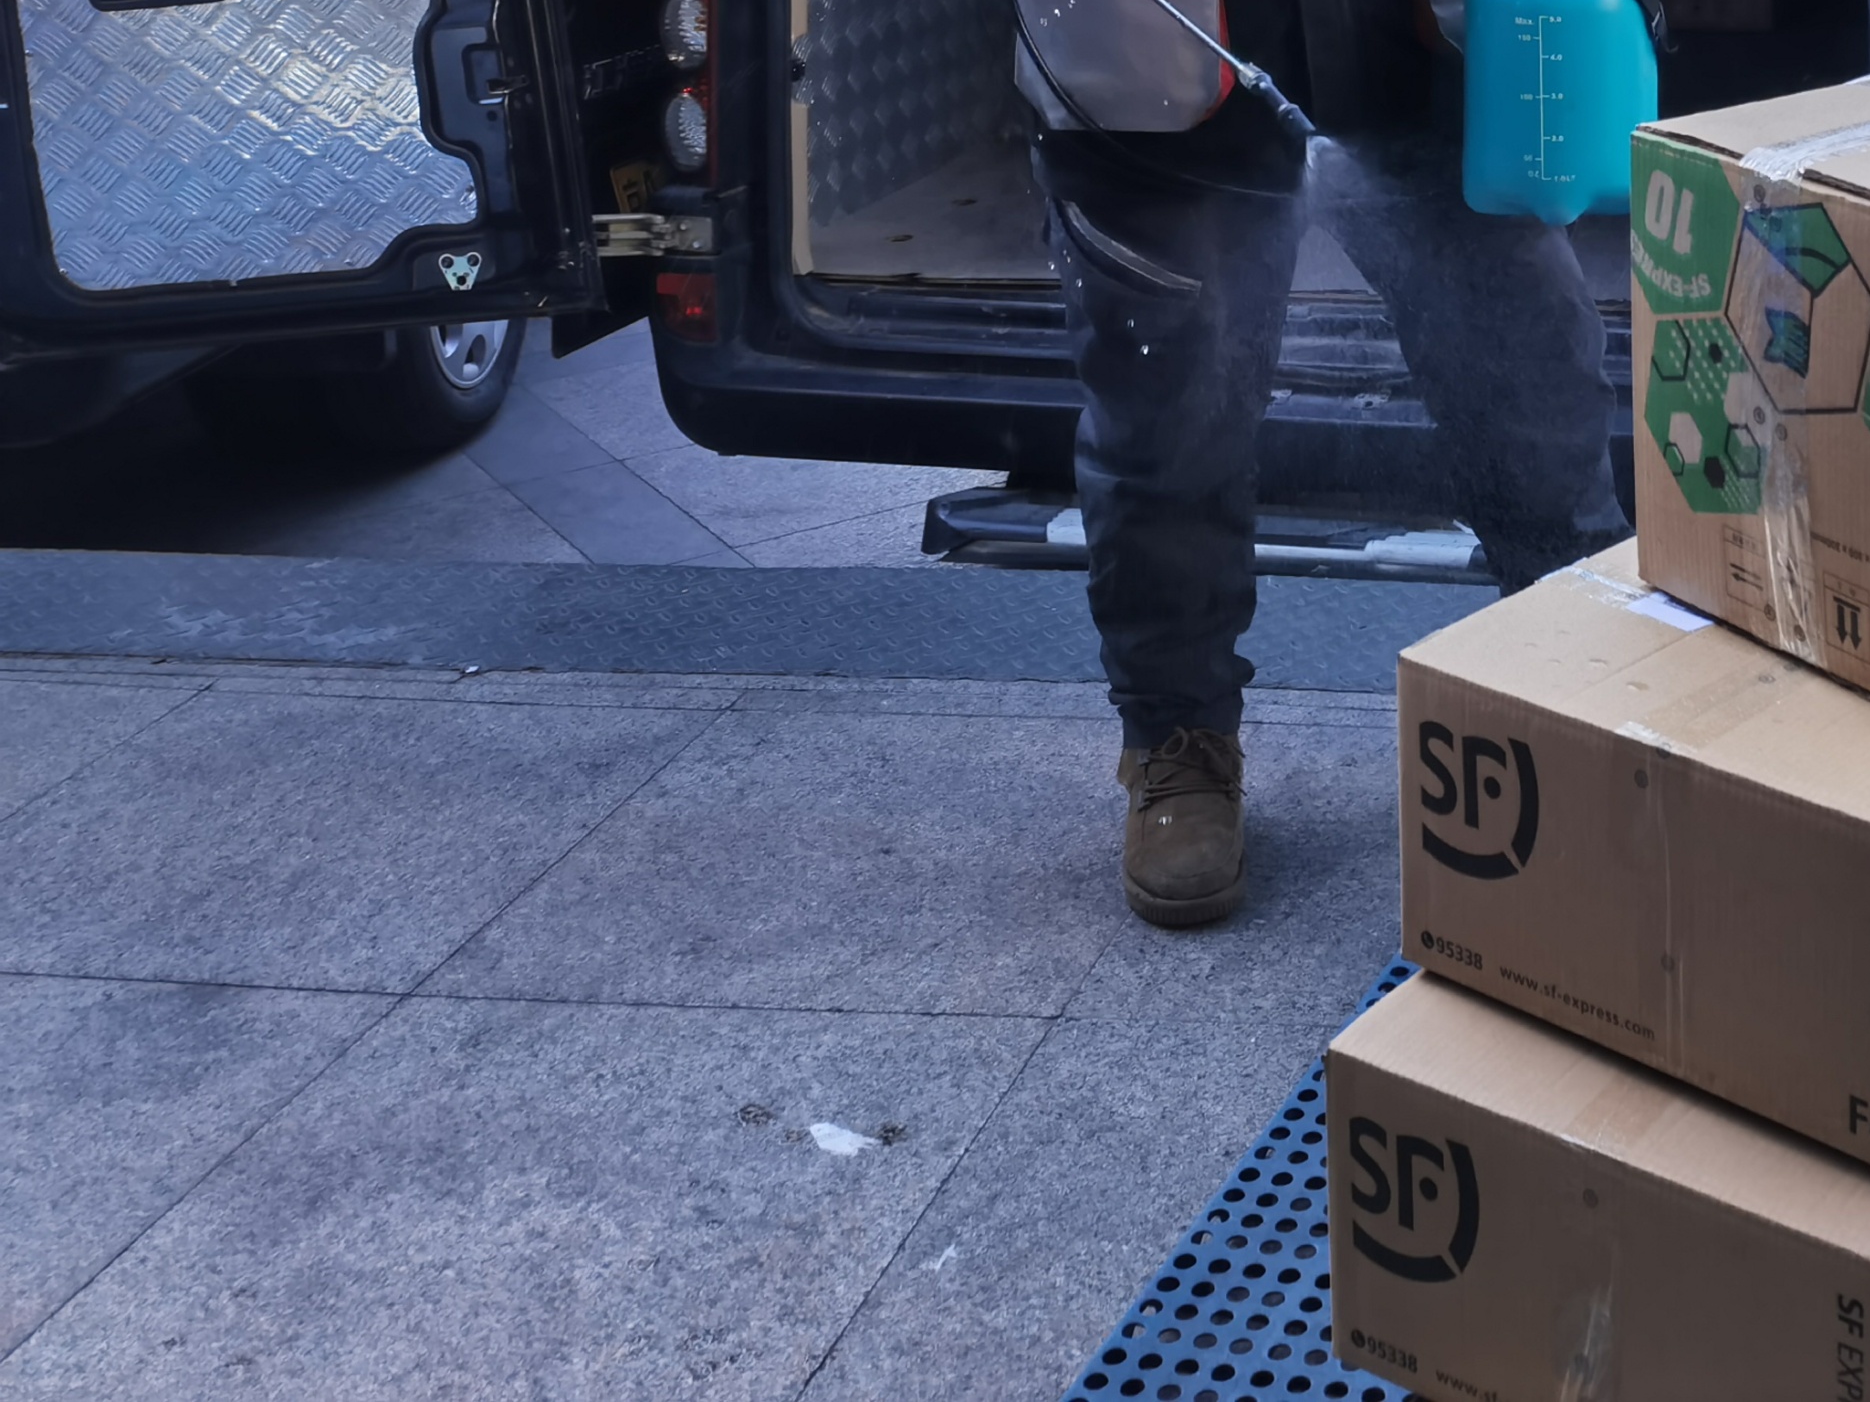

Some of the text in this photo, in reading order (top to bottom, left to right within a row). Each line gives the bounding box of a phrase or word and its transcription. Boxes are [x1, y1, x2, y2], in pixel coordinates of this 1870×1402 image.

[1645, 169, 1694, 255] 10
[1436, 936, 1656, 1041] 95338 www.sf-express.com
[1367, 1335, 1418, 1374] 95338
[1837, 1293, 1864, 1402] SF EXP
